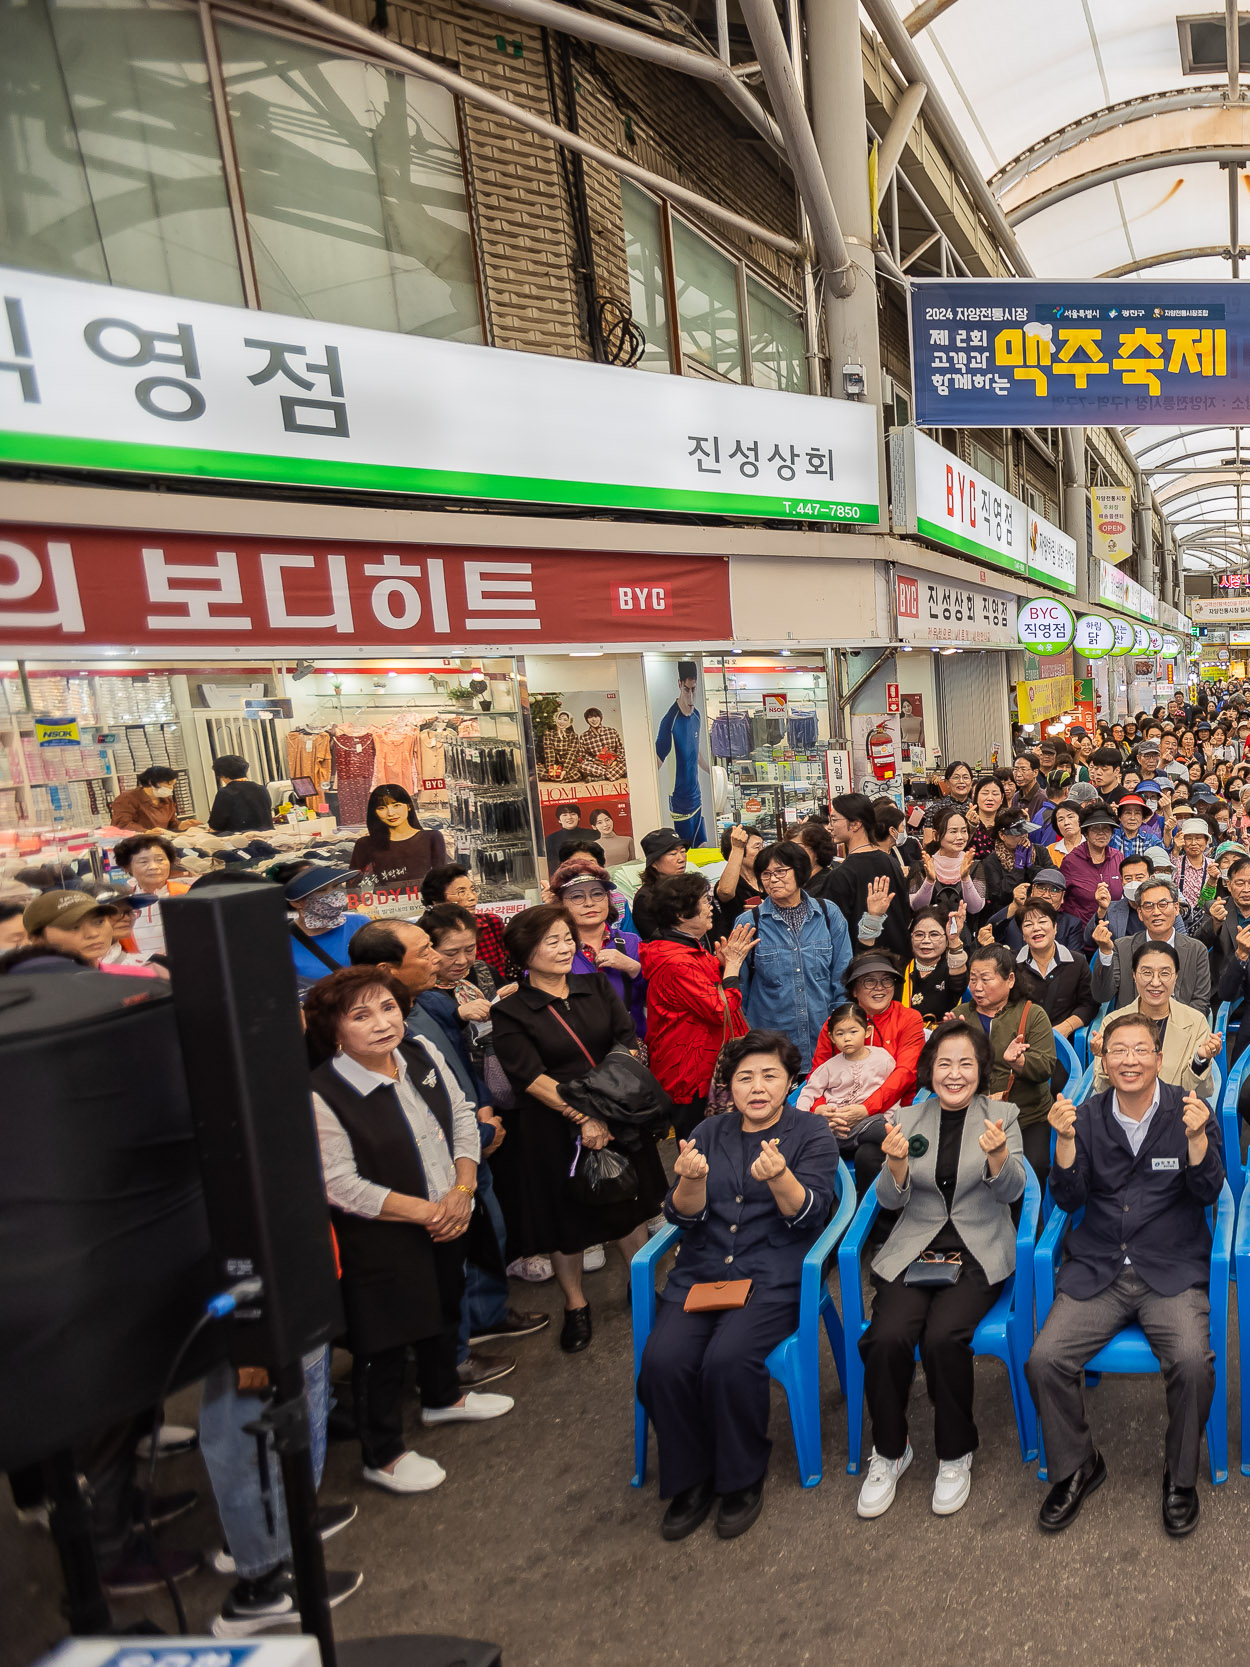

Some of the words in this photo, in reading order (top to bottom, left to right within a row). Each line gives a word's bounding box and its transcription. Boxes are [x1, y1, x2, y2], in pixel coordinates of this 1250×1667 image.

[926, 308, 953, 320] 2024
[956, 307, 1028, 321] 자양전통시장
[1064, 309, 1100, 318] 서울특별시
[929, 329, 949, 346] 제
[931, 351, 990, 374] 고객과
[994, 326, 1110, 397] 맥주
[1112, 327, 1227, 397] 축제
[931, 373, 1011, 396] 함께하는
[688, 435, 835, 481] 진성상회
[783, 500, 861, 519] T.447-7850
[945, 463, 977, 529] BYC
[981, 489, 1013, 547] 직영점
[1101, 524, 1123, 532] OPEN
[142, 548, 543, 633] 보디히트
[618, 586, 667, 611] BYC
[900, 582, 918, 614] BYC
[927, 585, 976, 623] 진성상회
[982, 597, 1008, 627] 직영점
[1029, 607, 1059, 620] BYC
[1024, 622, 1066, 639] 직영점
[1085, 621, 1102, 631] 하림
[43, 730, 72, 738] NSOK
[832, 755, 843, 780] 타월
[425, 779, 444, 789] BYC
[540, 785, 582, 800] HOME
[585, 782, 629, 797] WEAR
[346, 888, 400, 910] BODY
